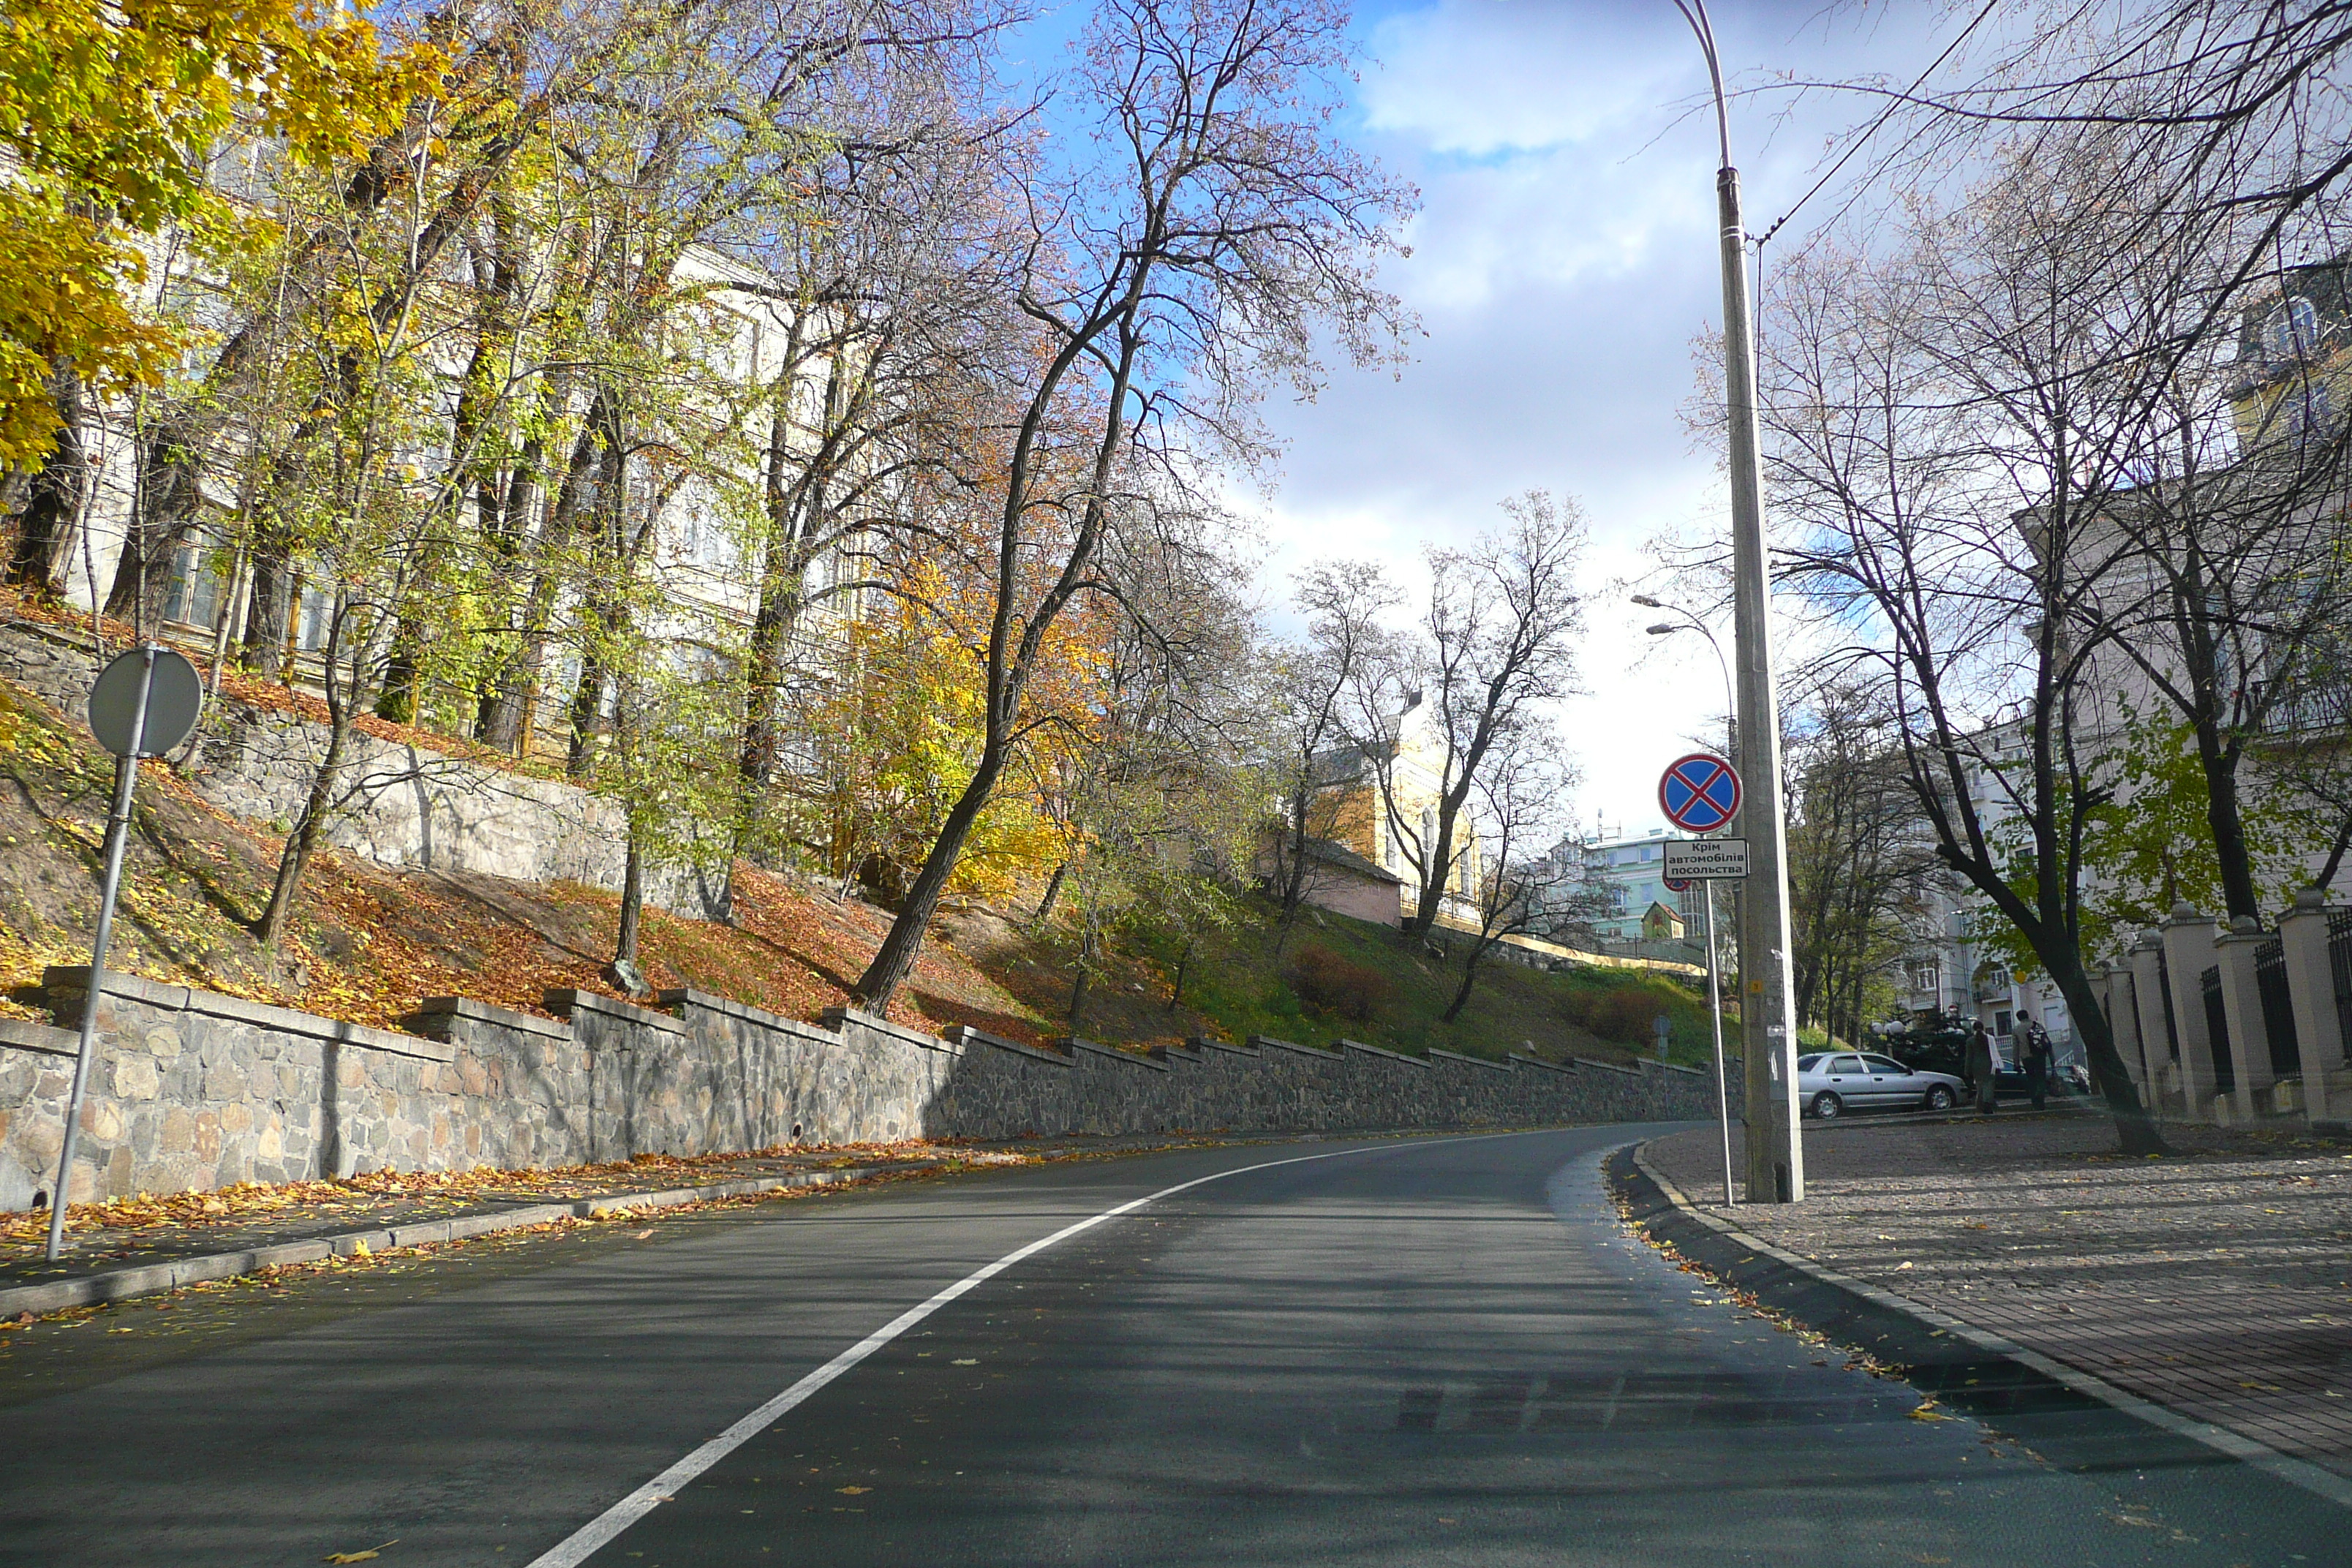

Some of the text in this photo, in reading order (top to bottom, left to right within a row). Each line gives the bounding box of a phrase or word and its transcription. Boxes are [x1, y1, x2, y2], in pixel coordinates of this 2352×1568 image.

[1692, 843, 1721, 853] Крім
[1669, 853, 1744, 864] автомобілів
[1671, 866, 1743, 875] посольства
